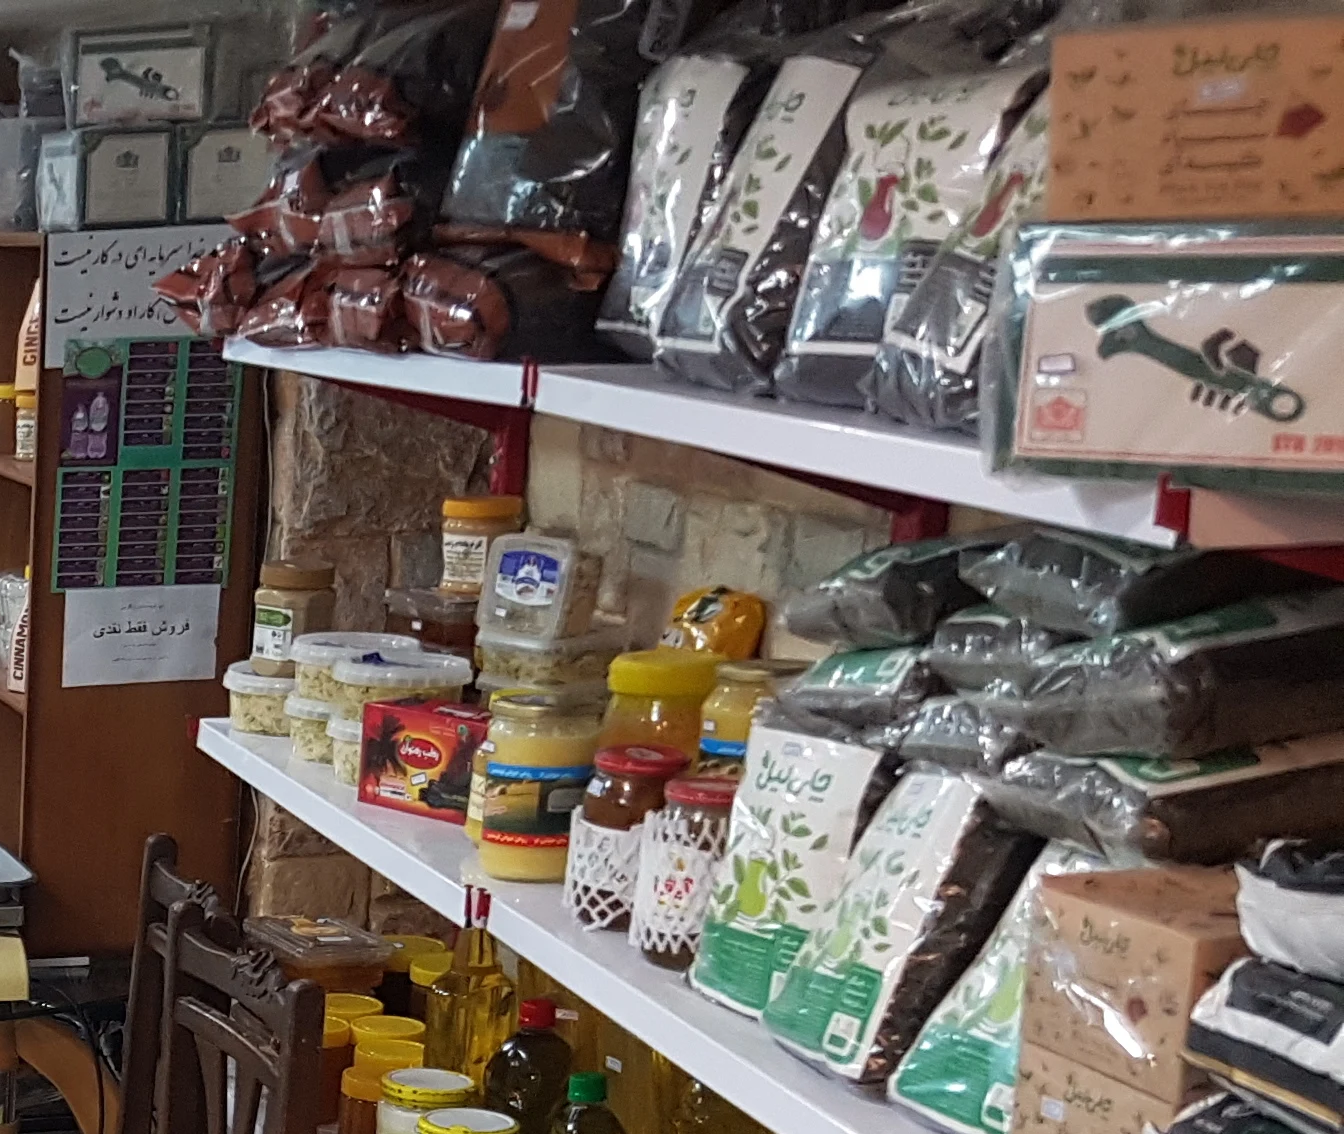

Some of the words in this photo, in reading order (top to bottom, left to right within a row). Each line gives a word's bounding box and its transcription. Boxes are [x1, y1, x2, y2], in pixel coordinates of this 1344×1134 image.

[93, 622, 121, 638] نقدی
[124, 620, 147, 634] فقط
[151, 617, 190, 636] فروش
